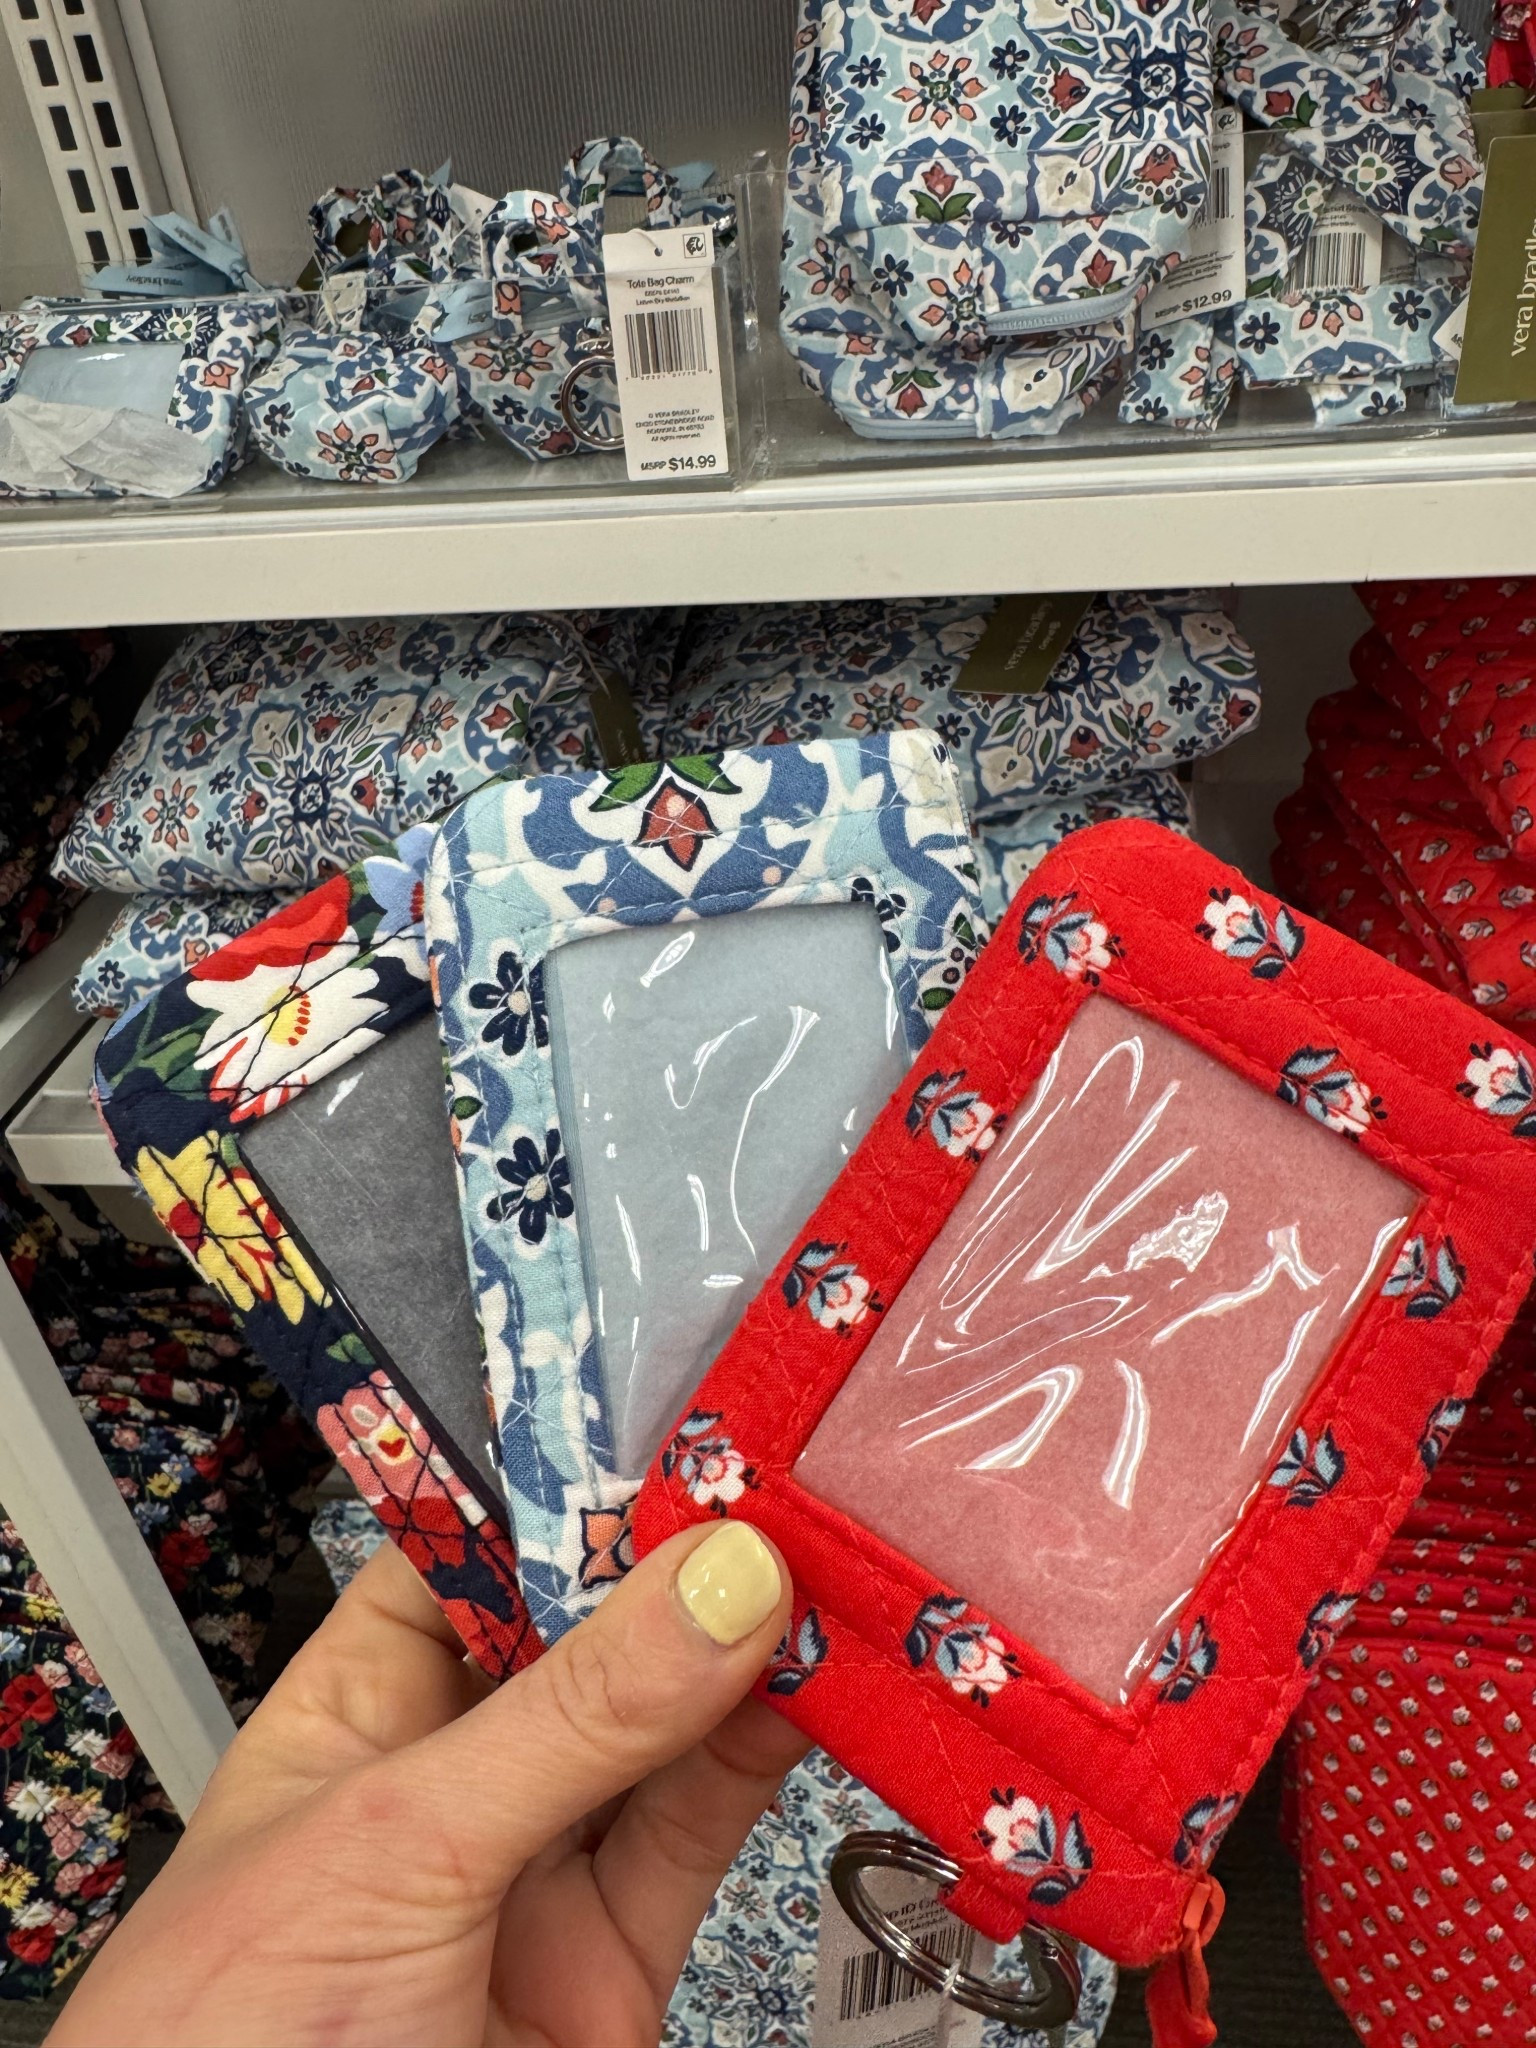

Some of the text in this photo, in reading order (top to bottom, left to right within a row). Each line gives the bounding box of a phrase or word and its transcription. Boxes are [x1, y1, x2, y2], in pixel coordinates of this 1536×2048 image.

[626, 276, 695, 289] Tote Bag Charm
[1511, 218, 1536, 357] vera bradl
[1182, 289, 1233, 313] $12.99
[668, 454, 717, 472] $14.99
[1004, 641, 1029, 671] vera
